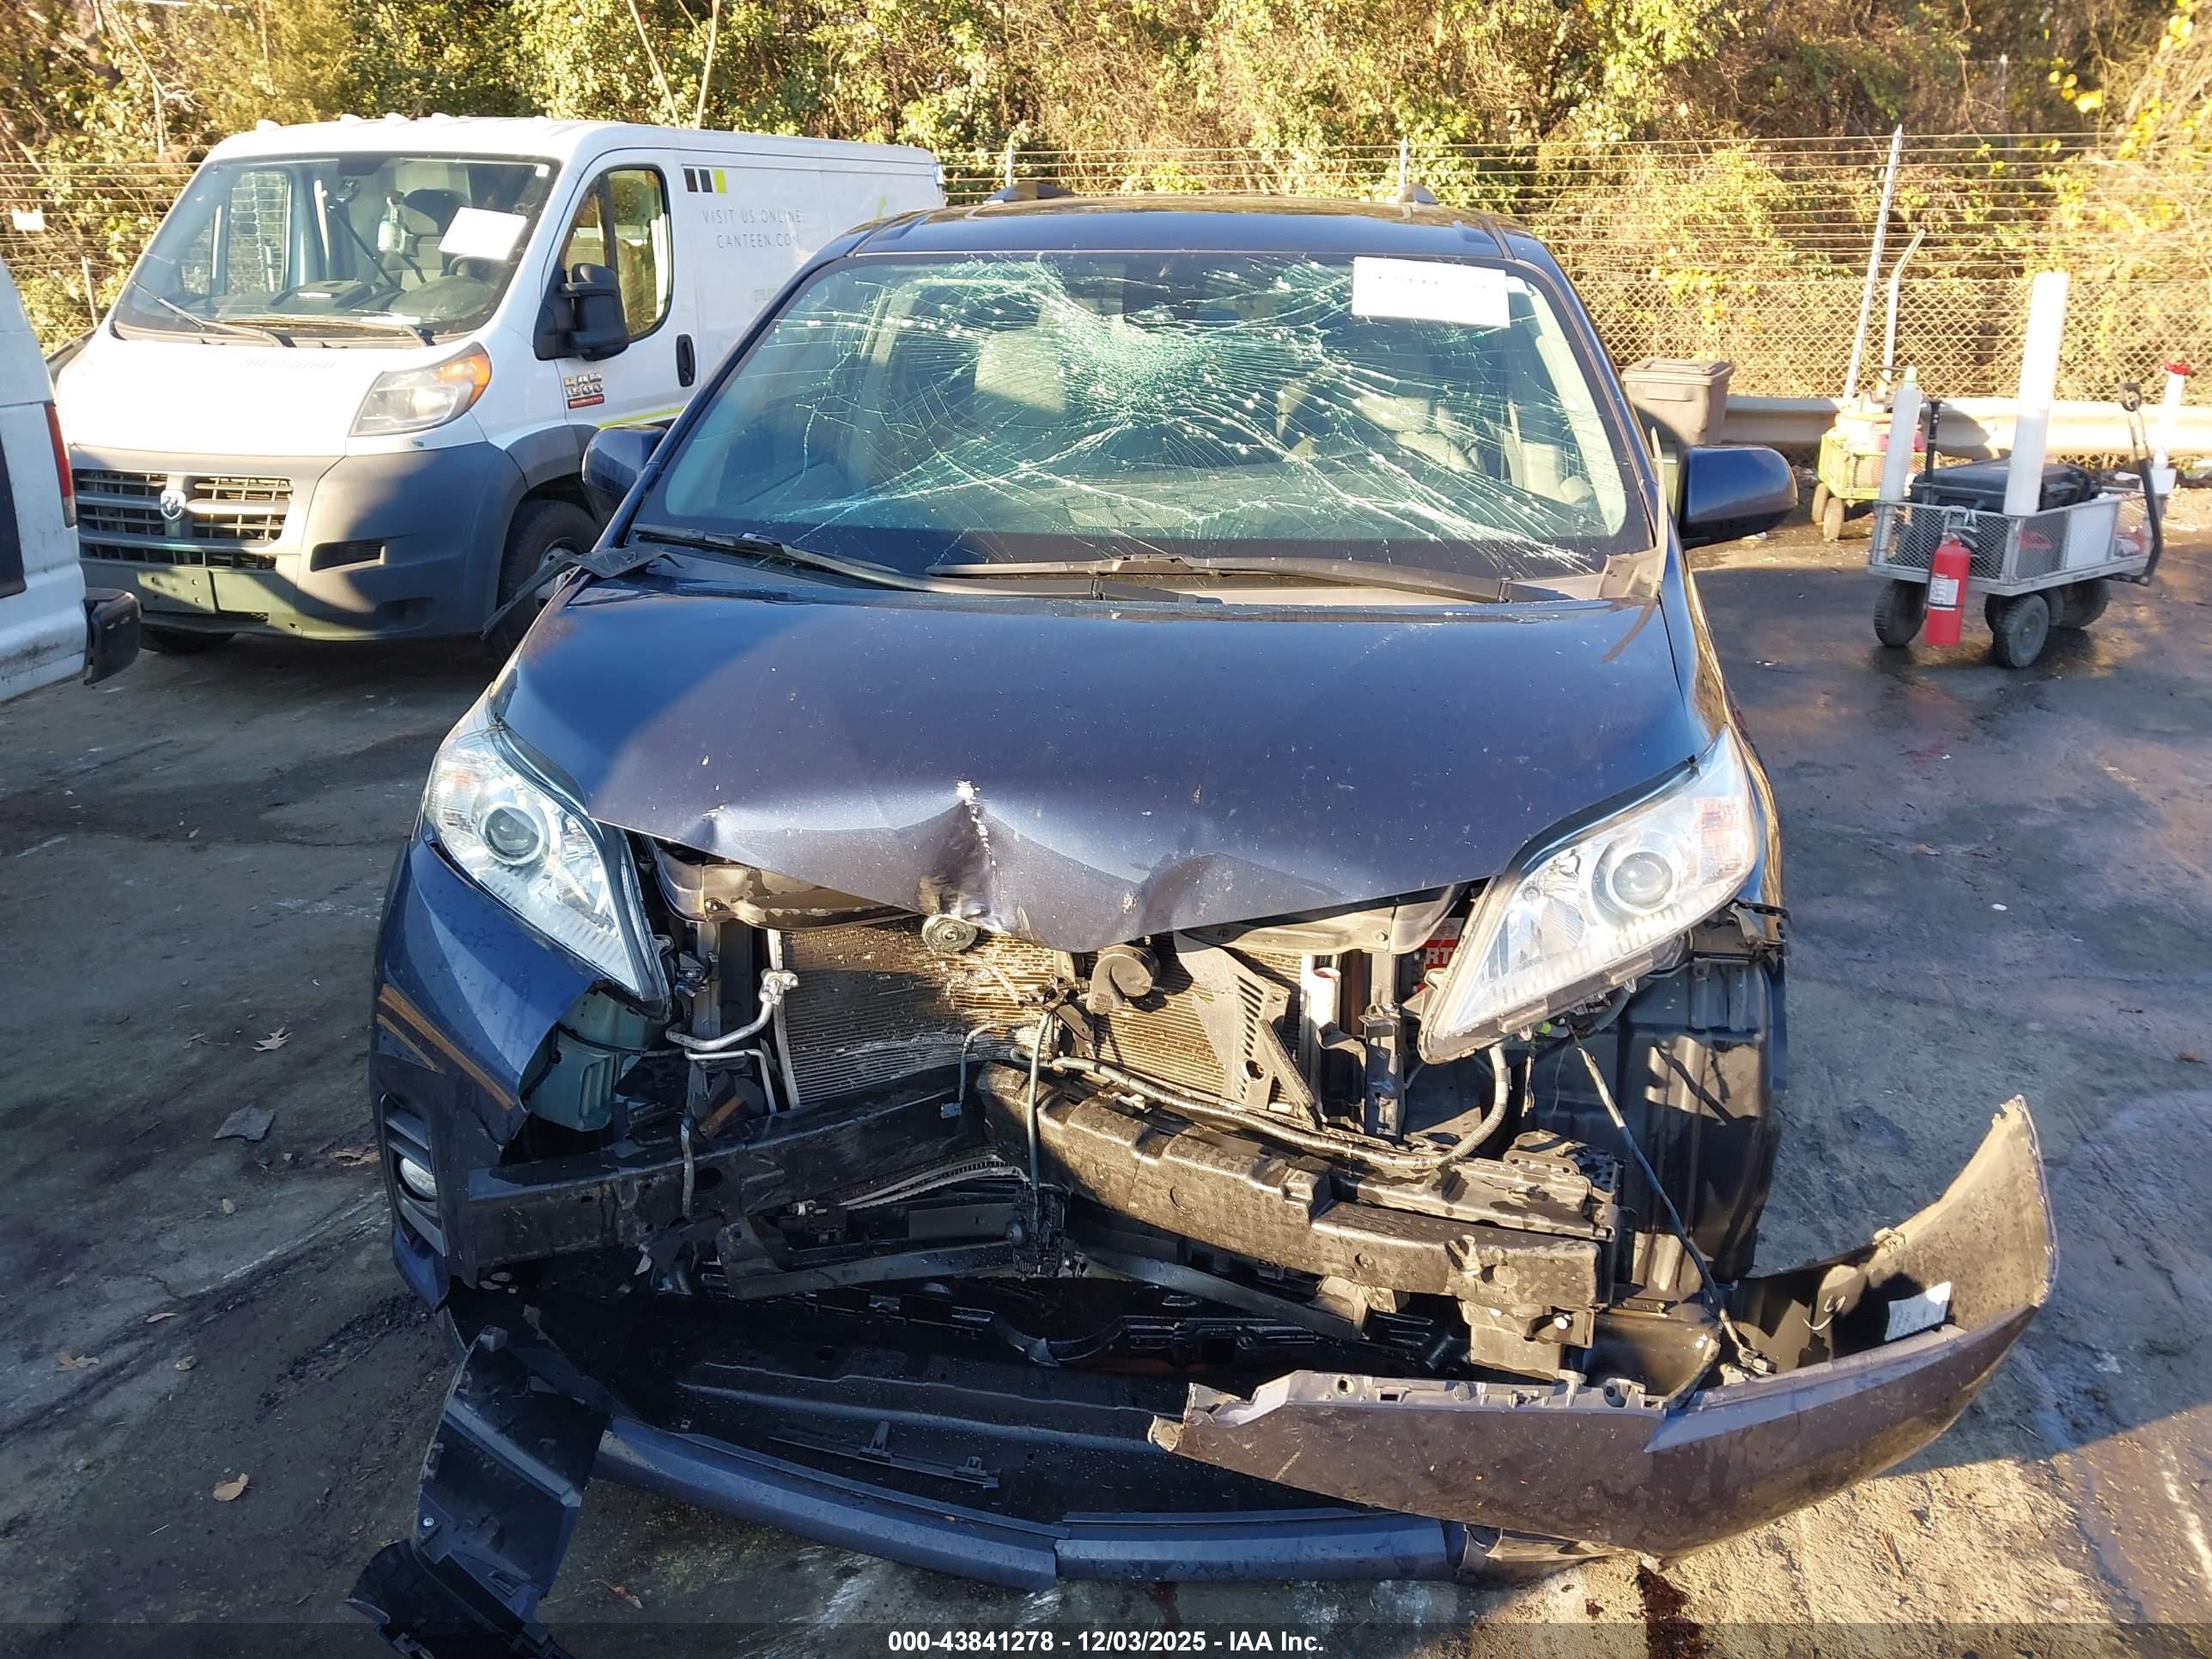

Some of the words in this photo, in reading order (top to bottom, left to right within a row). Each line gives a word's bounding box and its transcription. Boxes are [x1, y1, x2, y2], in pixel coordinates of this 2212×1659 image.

[702, 210, 734, 224] VISIT
[741, 209, 756, 224] US
[763, 209, 801, 223] ONLINE
